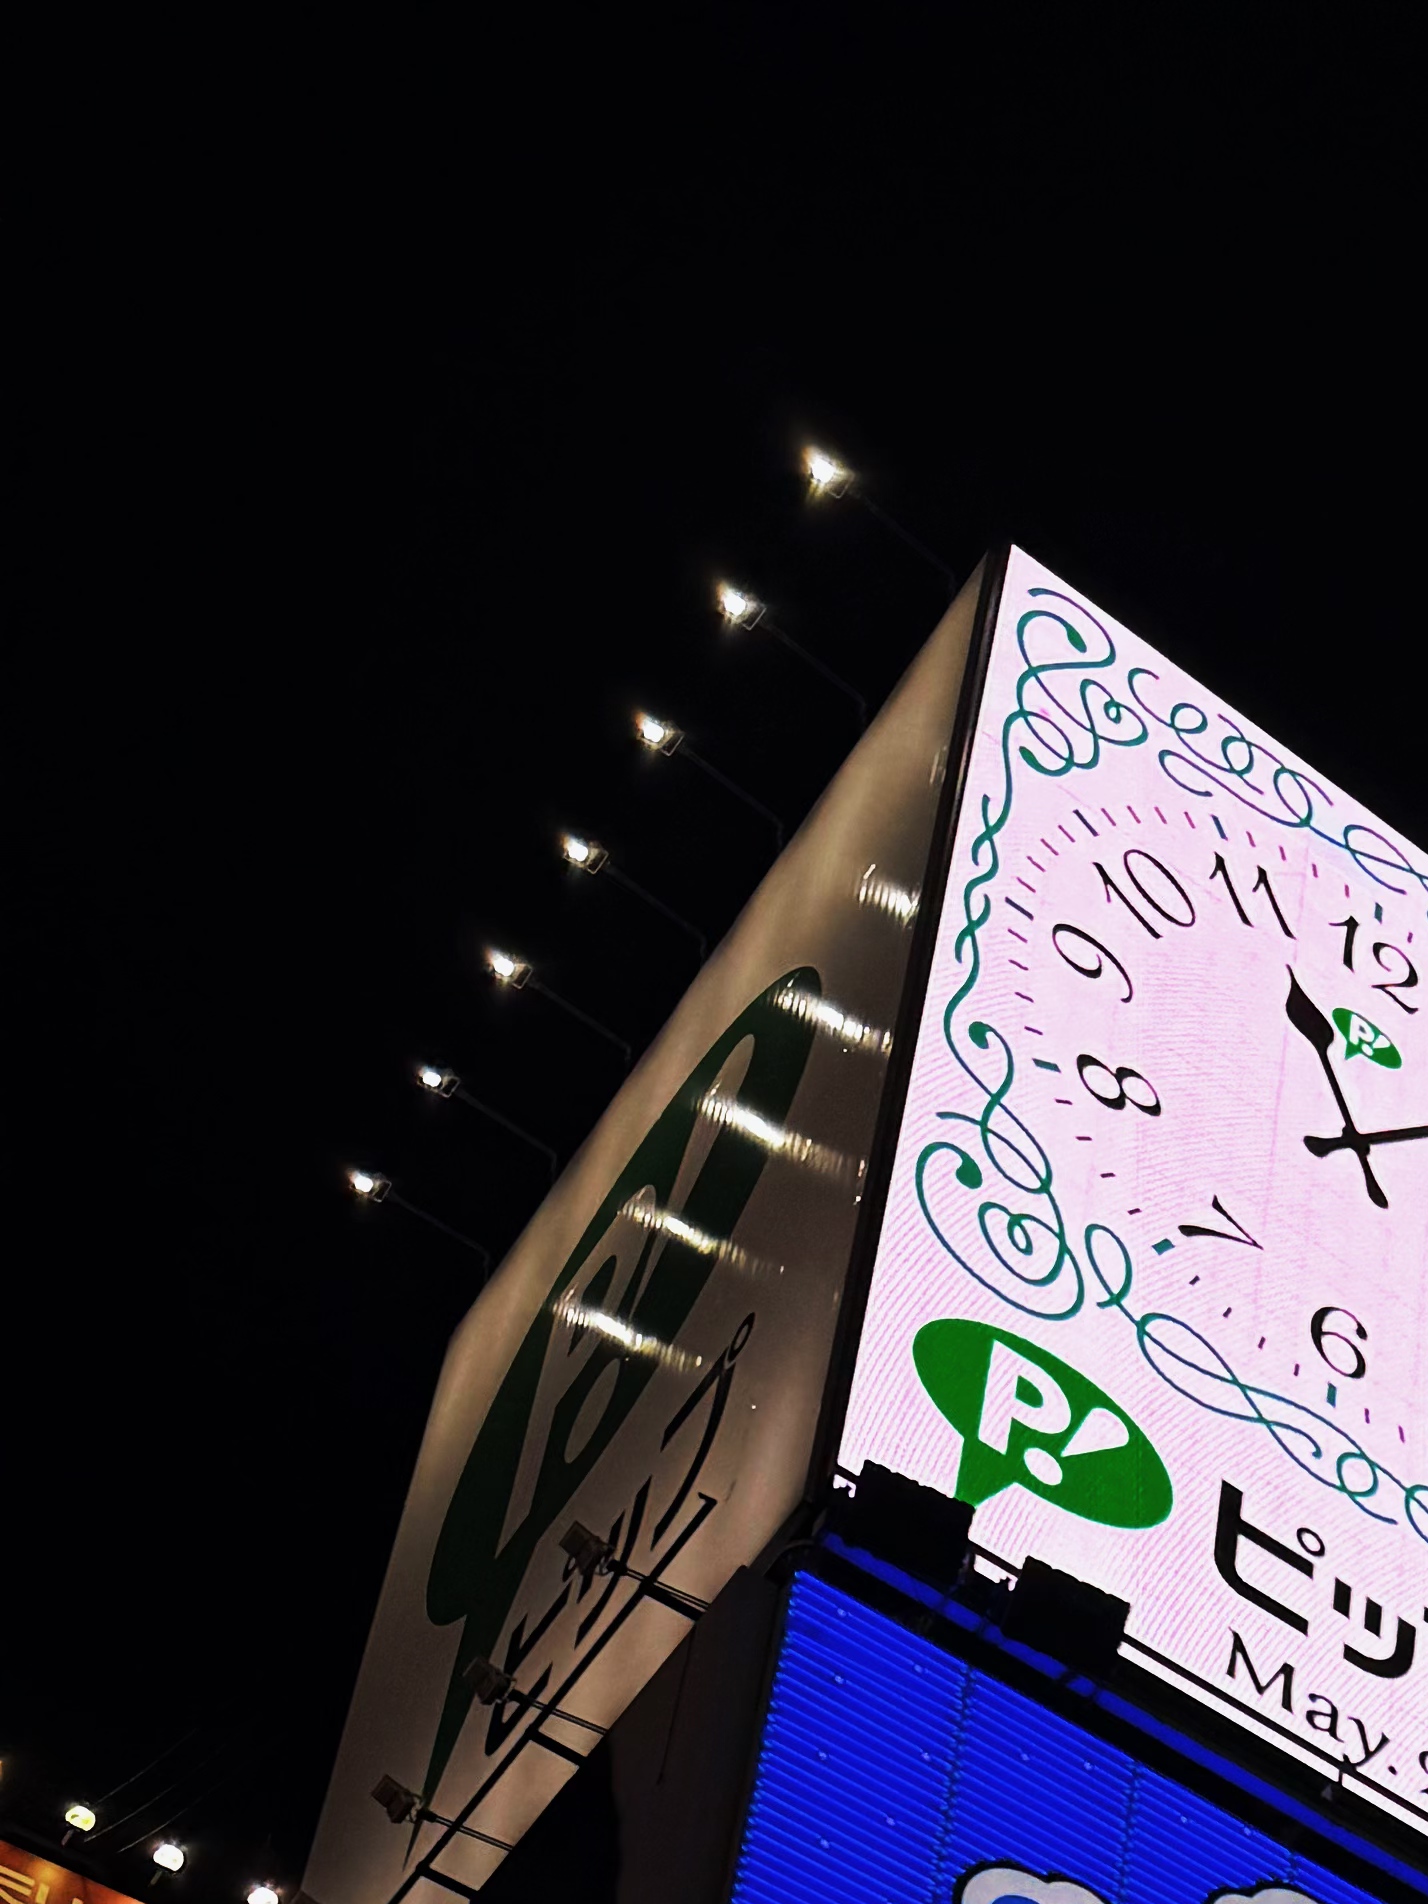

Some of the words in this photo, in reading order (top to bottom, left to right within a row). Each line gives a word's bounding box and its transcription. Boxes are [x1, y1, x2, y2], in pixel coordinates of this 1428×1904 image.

[1093, 850, 1196, 938] 10
[1210, 854, 1295, 938] 11
[1052, 923, 1131, 1002] 9
[1331, 917, 1417, 1014] 12
[1076, 1052, 1161, 1116] 8
[1178, 1194, 1263, 1249] 7
[1310, 1305, 1368, 1379] 6
[1225, 1630, 1398, 1777] May.
